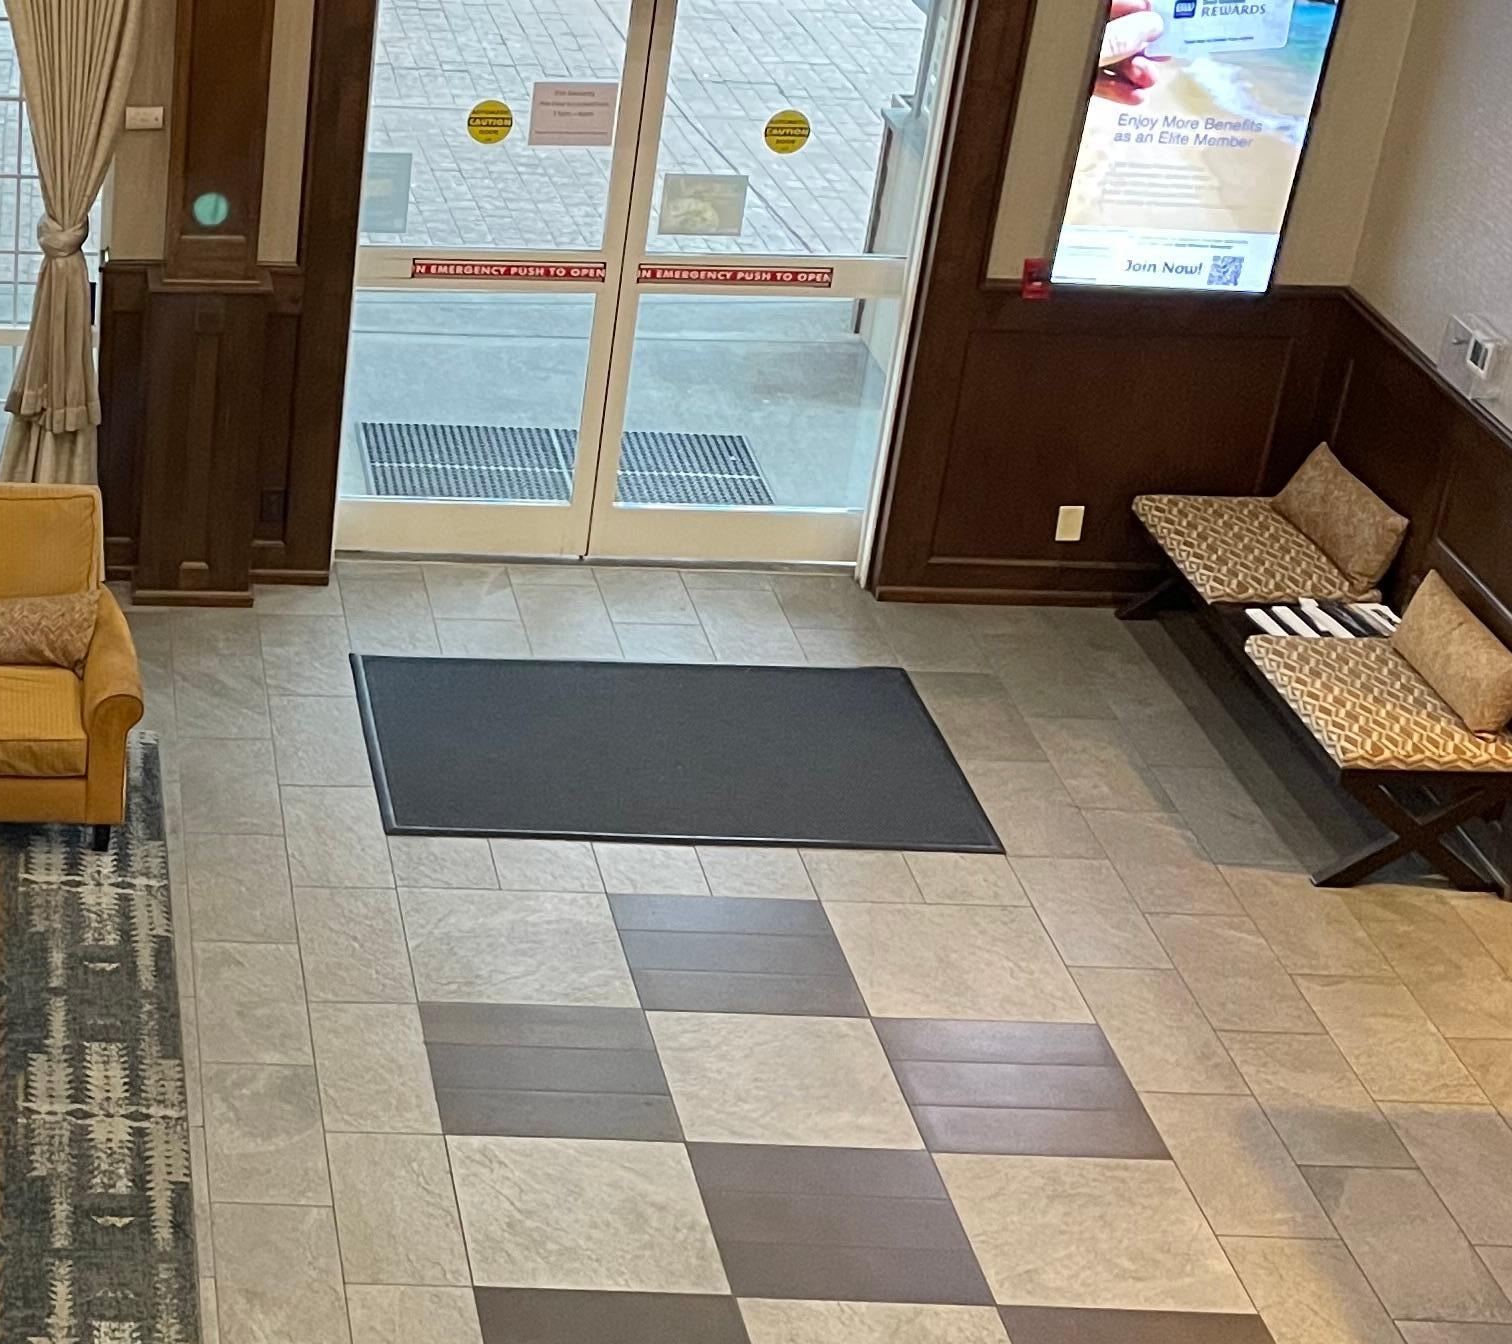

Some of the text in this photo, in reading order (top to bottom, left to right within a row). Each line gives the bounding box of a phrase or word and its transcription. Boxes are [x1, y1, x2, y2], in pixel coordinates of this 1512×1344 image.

[1201, 3, 1266, 17] REWARDS
[469, 118, 511, 126] CAUTION
[1117, 113, 1263, 133] Enjoy More Benefits
[1113, 131, 1253, 148] as an Elite Member
[412, 264, 606, 278] N EMERGENCY PUSH TO OPEN
[1125, 259, 1203, 275] Join Now!
[656, 269, 733, 281] EMERGENCY
[737, 271, 771, 281] PUSH
[776, 272, 794, 282] TO
